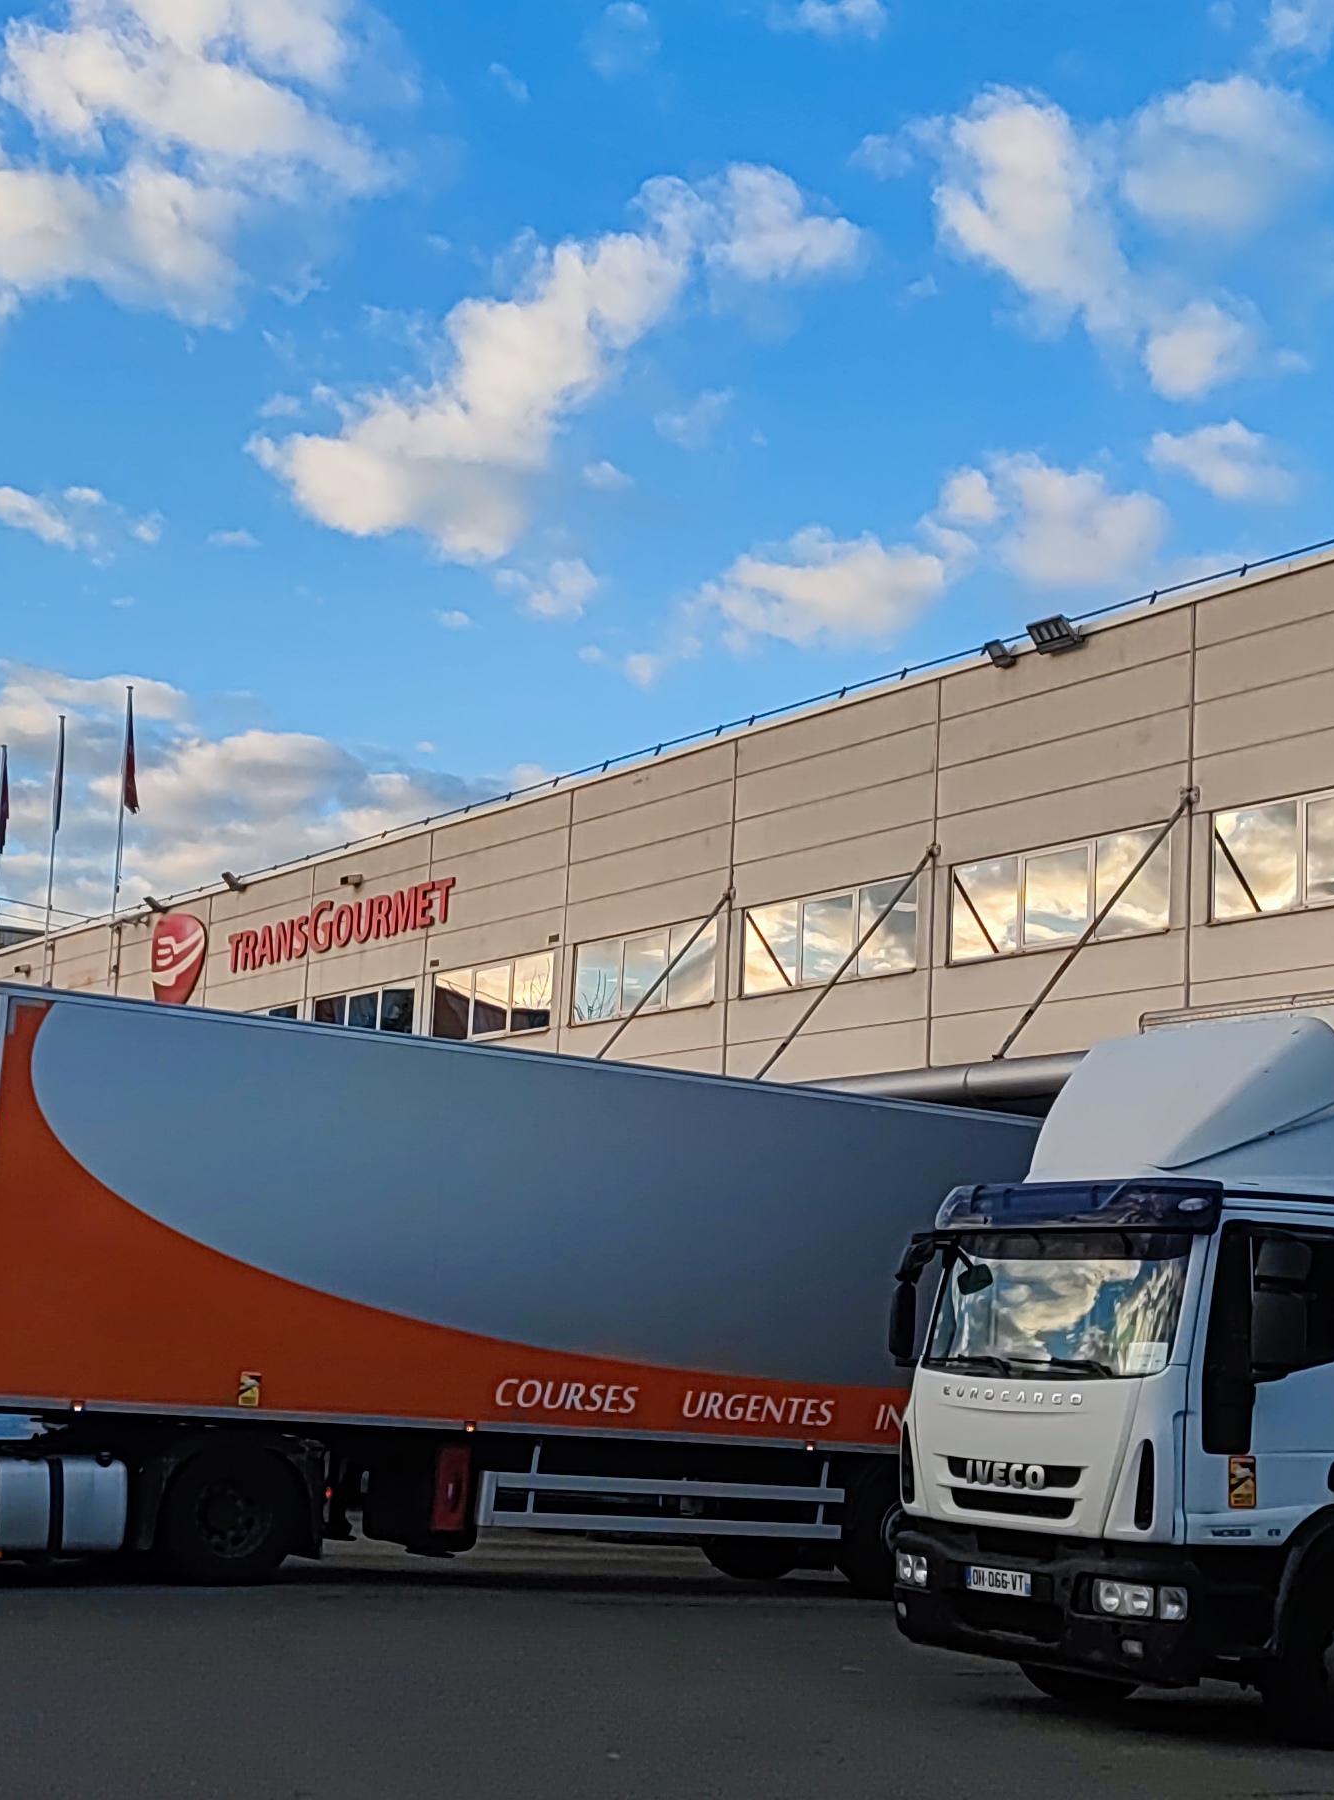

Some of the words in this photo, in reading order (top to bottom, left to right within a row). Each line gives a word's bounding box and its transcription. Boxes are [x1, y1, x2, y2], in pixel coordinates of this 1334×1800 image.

[228, 877, 456, 973] TRANSGOURMET
[495, 1378, 639, 1414] COURSES
[682, 1390, 835, 1426] URGENTES
[943, 1385, 1083, 1406] EUROCARGO
[966, 1459, 1046, 1491] IVECO
